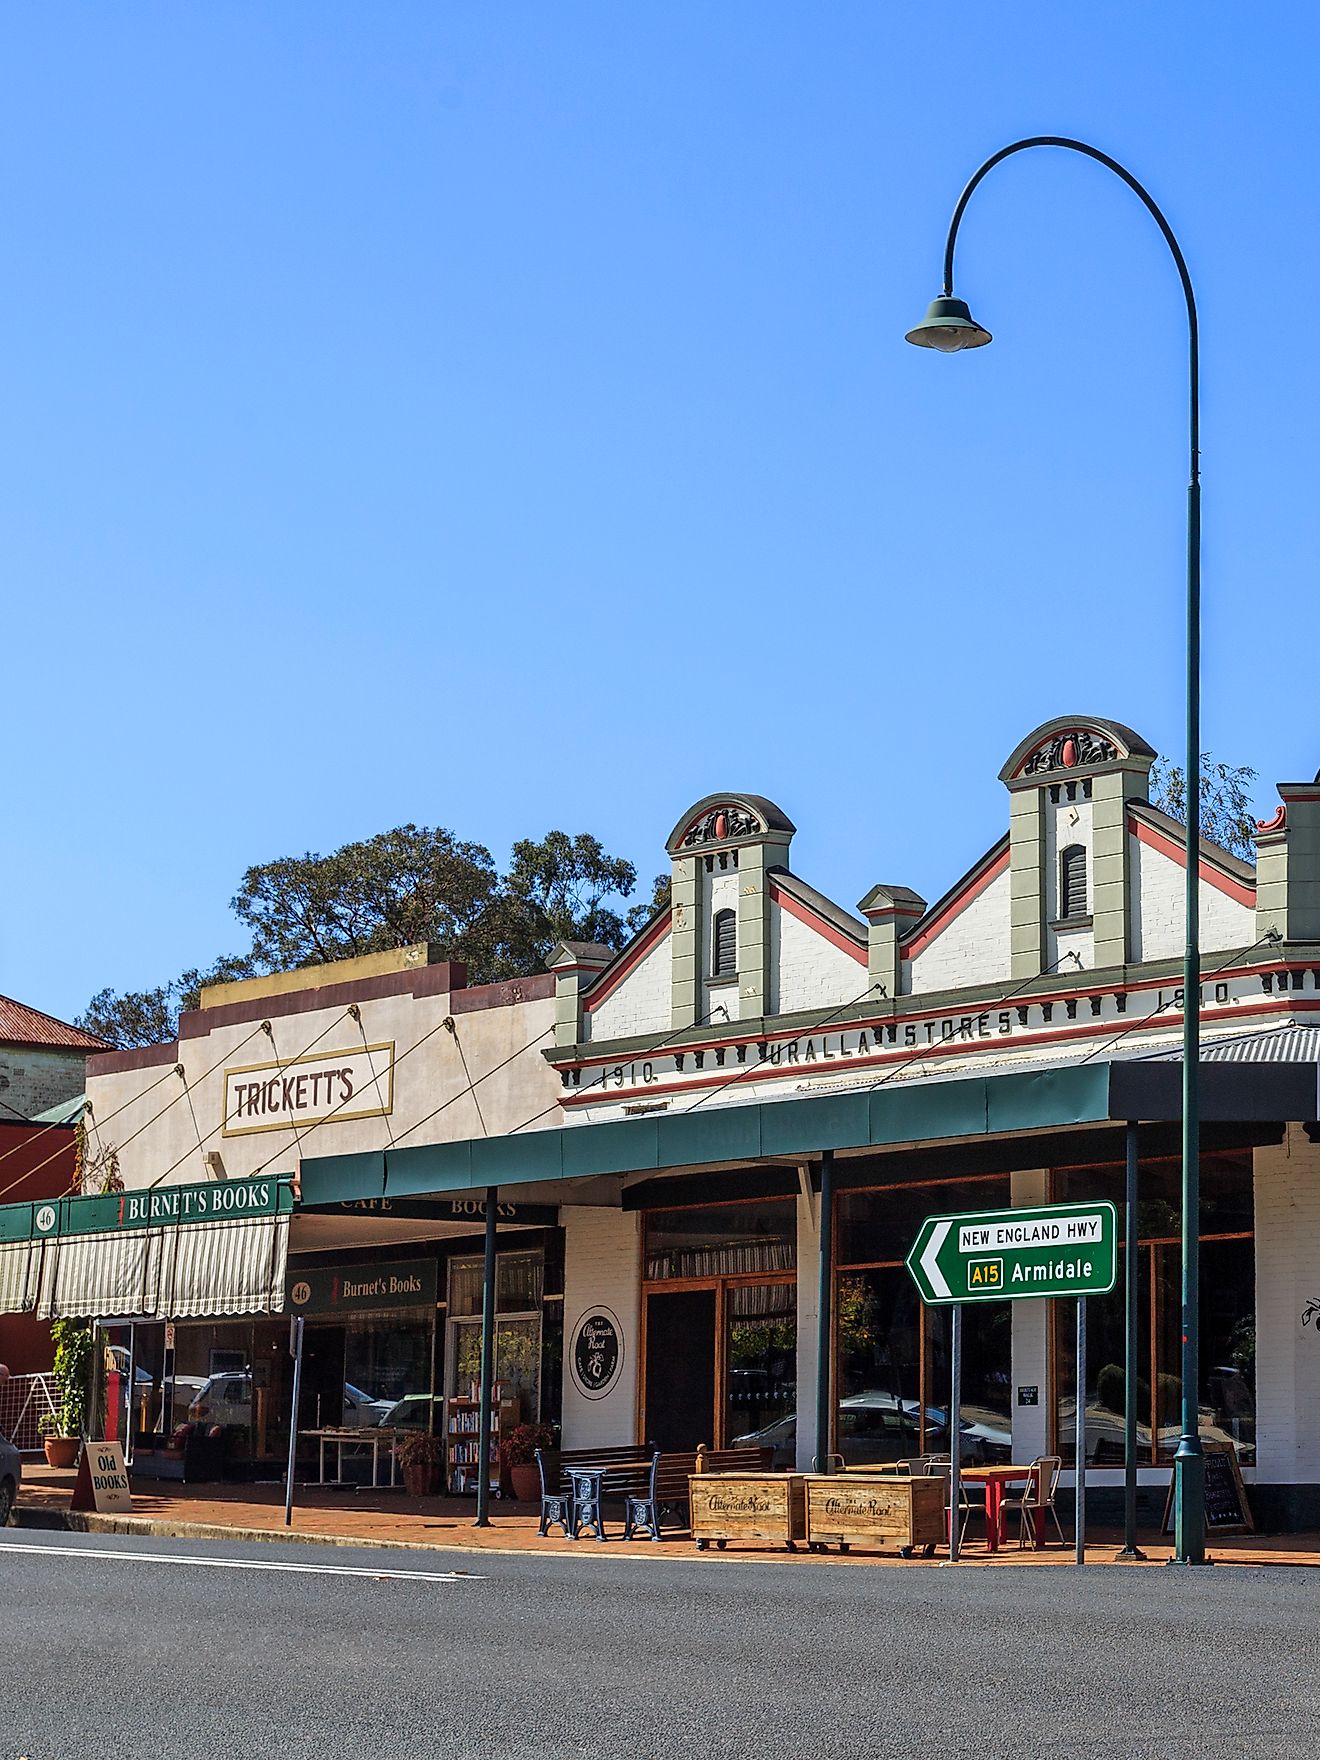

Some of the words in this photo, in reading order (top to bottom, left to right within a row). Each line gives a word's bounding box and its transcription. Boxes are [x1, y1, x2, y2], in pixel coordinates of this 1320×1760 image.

[770, 1033, 871, 1066] URALLA
[905, 1013, 1010, 1046] STORES
[235, 1068, 353, 1118] TRICKETT'S
[129, 1190, 207, 1220] BURNET'S
[212, 1184, 269, 1211] BOOKS
[39, 1209, 52, 1227] 46
[962, 1230, 990, 1247] NEW
[996, 1224, 1060, 1244] ENGLAND
[1067, 1221, 1098, 1238] HWY
[971, 1265, 999, 1284] A15
[1011, 1258, 1093, 1282] Armidale
[294, 1286, 307, 1300] 46
[343, 1277, 387, 1298] Burnet's
[390, 1275, 421, 1294] Books
[97, 1454, 117, 1472] Old
[93, 1474, 128, 1490] BOOKS
